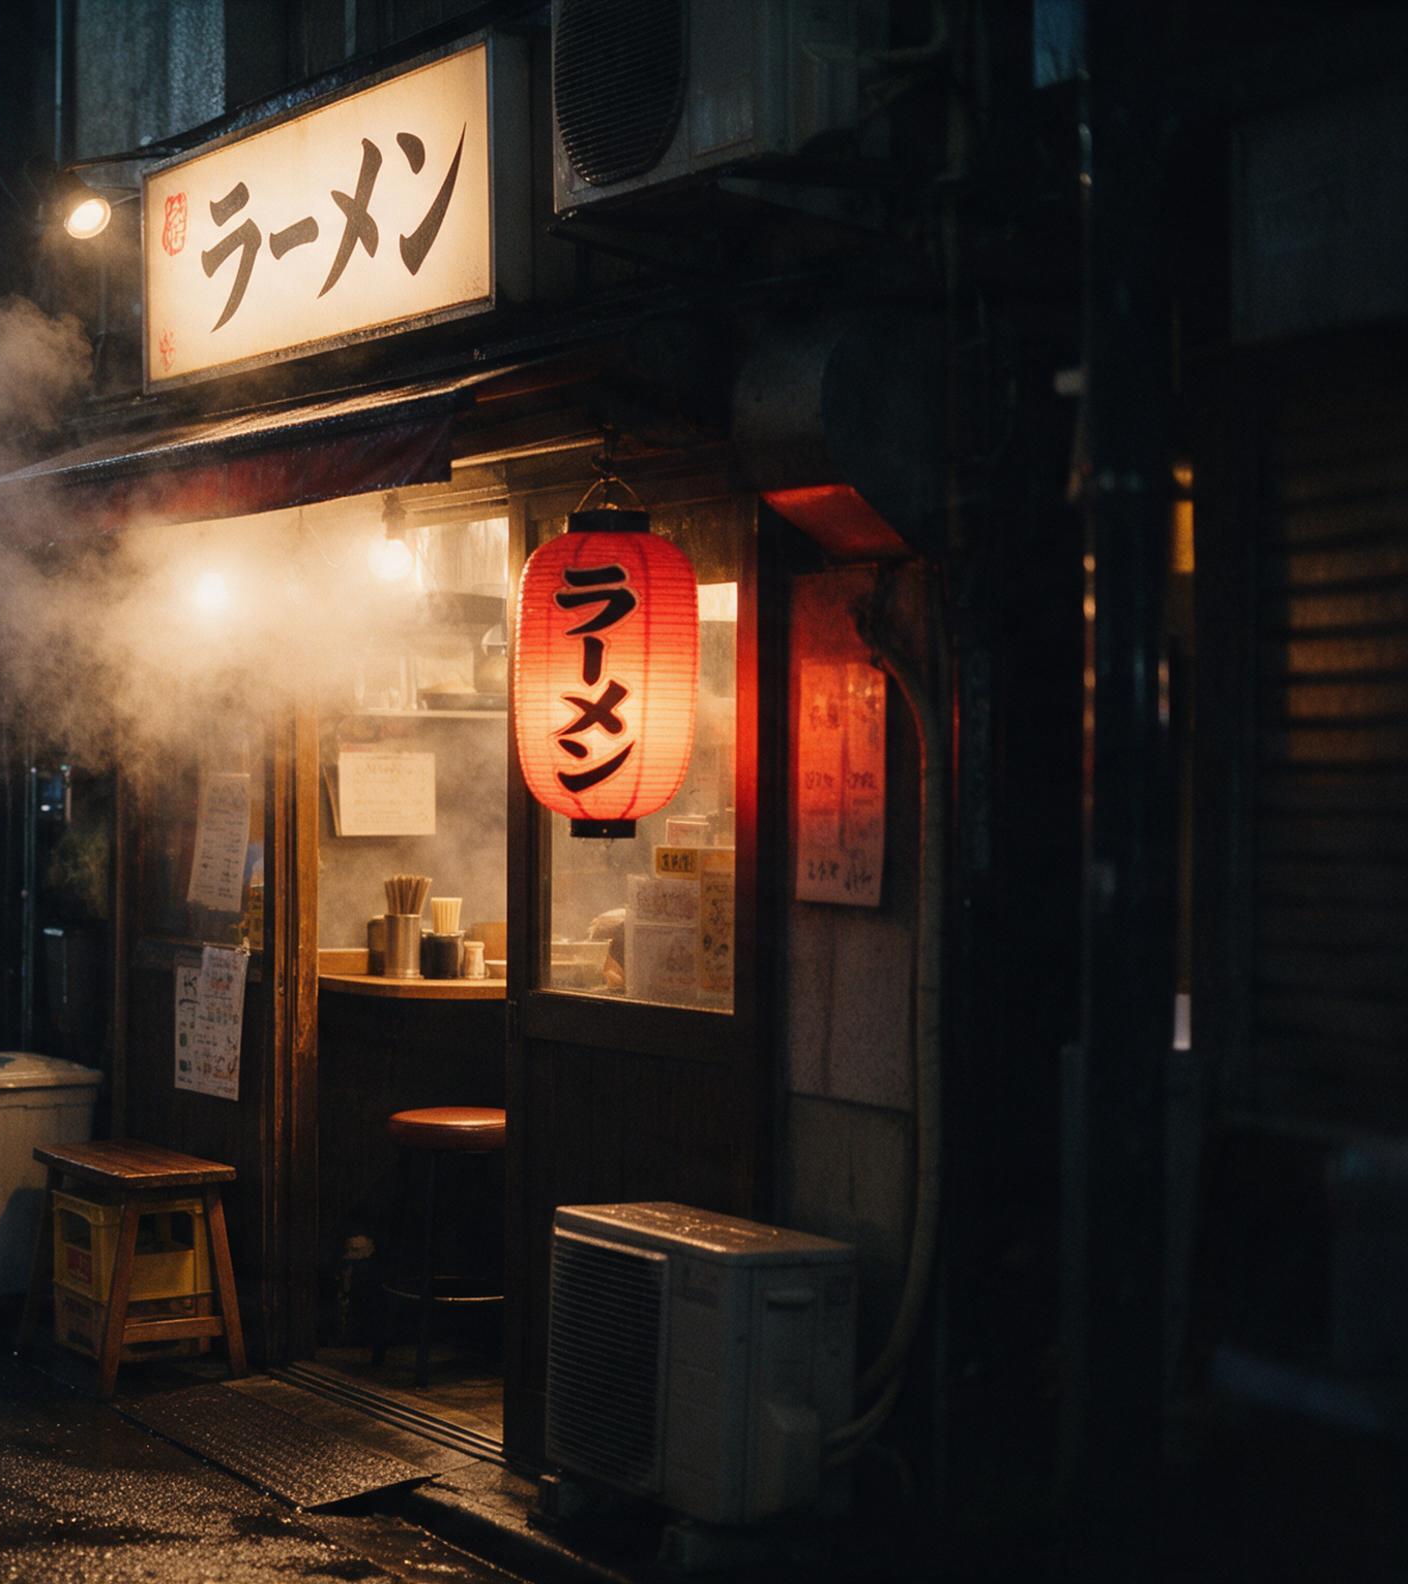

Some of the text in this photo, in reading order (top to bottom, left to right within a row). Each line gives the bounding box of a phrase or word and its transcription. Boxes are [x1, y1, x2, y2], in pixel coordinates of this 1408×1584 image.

[201, 121, 467, 334] ラーメン
[554, 564, 637, 793] ラーメン
